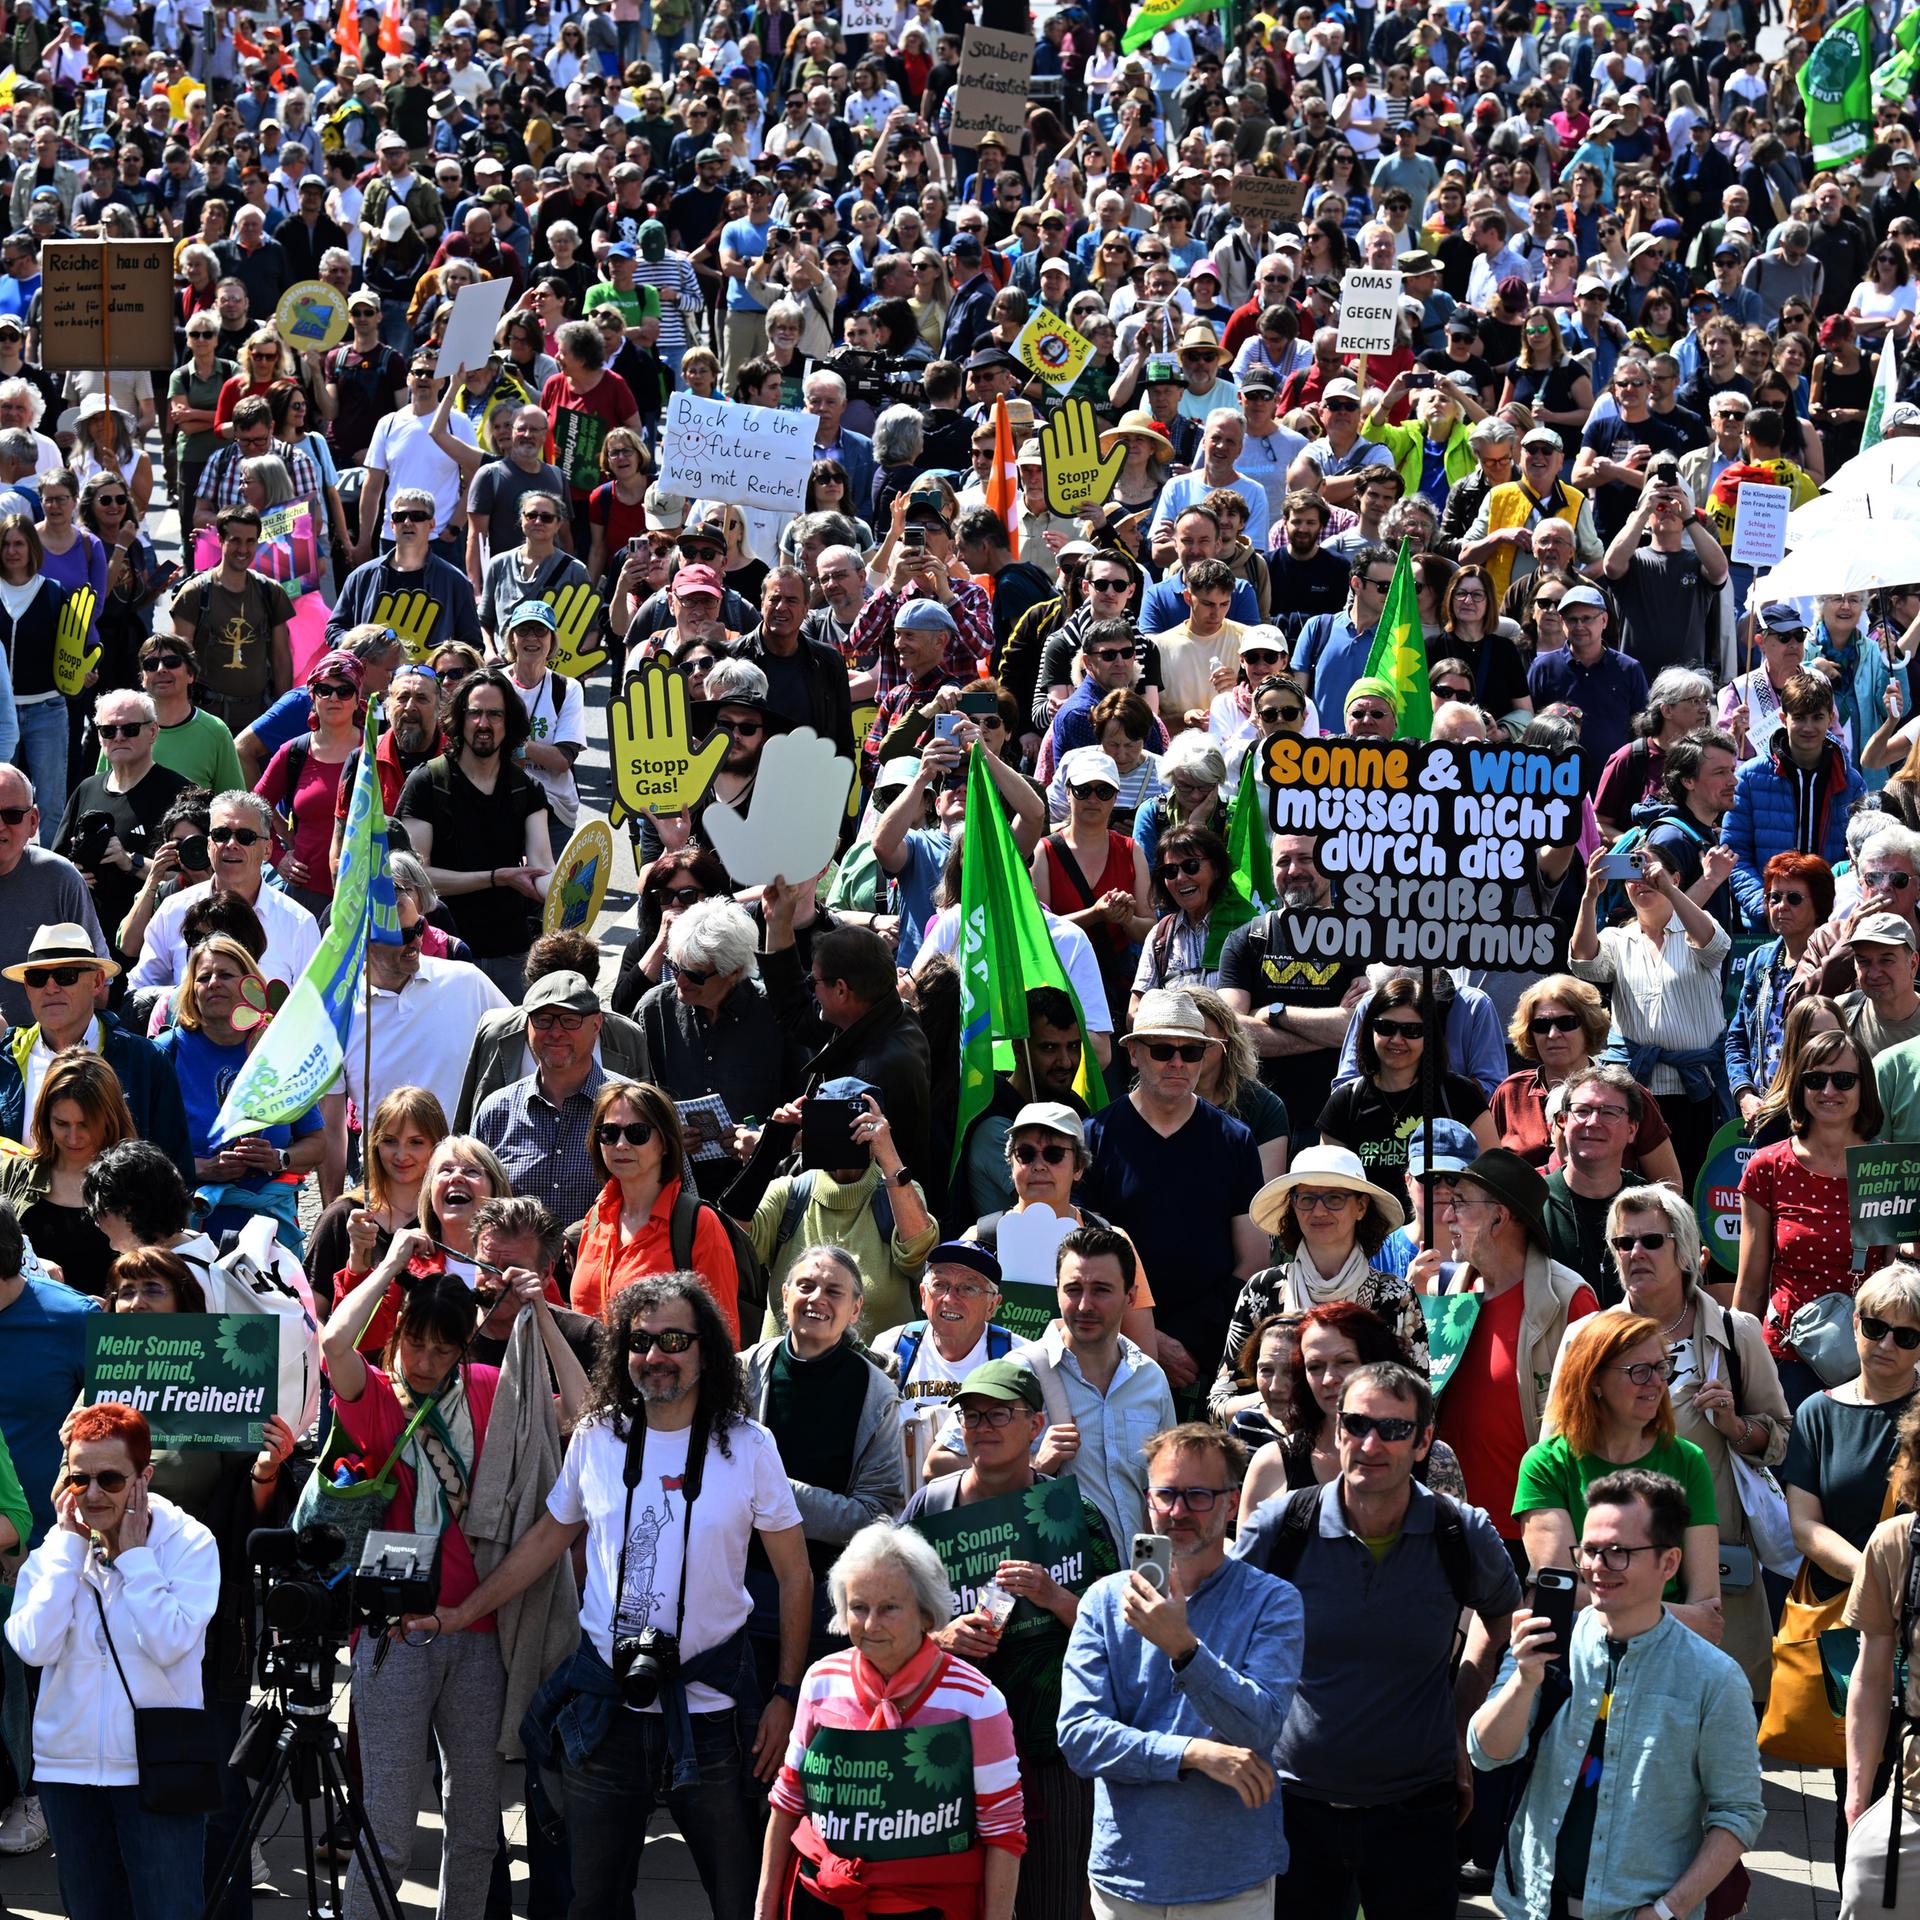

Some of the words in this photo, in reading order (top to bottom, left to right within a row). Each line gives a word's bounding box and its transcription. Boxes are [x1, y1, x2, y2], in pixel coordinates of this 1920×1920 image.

[969, 41, 1029, 64] Sauber
[955, 111, 1022, 135] bezahlbar
[1234, 180, 1298, 194] NOSTALGIE
[1232, 204, 1299, 221] STRATEGIE
[49, 254, 100, 272] Reiche
[116, 253, 140, 270] hau
[143, 253, 161, 270] ab
[1350, 275, 1393, 290] OMAS
[54, 301, 76, 313] nicht
[108, 298, 144, 313] dumm
[1346, 305, 1393, 320] GEGEN
[1038, 311, 1089, 353] REICHE
[1340, 336, 1391, 350] RECHTS
[1022, 343, 1035, 369] NEIN
[1033, 366, 1067, 382] DANKE
[678, 399, 728, 428] Back
[743, 411, 760, 432] to
[773, 416, 799, 436] the
[709, 434, 771, 461] future
[671, 466, 701, 488] weg
[711, 470, 738, 487] mit
[747, 475, 803, 499] Reiche!
[1058, 469, 1099, 486] Stopp
[1061, 484, 1091, 501] Gas!
[1752, 490, 1786, 501] Klimapolitik
[1753, 500, 1765, 508] Frau
[1744, 529, 1766, 539] Gesicht
[1748, 520, 1766, 529] Schlag
[1746, 539, 1772, 548] nächsten
[1737, 548, 1778, 560] Generationen.
[59, 648, 82, 669] Stopp
[58, 664, 76, 681] Gas!
[631, 759, 689, 776] Stopp
[1269, 738, 1409, 789] Sonne
[1418, 748, 1462, 791] &
[1470, 750, 1580, 797] Wind
[636, 777, 678, 795] Gas!
[1276, 787, 1440, 835] müssen
[1454, 793, 1570, 841] nicht
[1321, 829, 1447, 877] durch
[1458, 837, 1525, 880] die
[1343, 872, 1502, 922] Straße
[1288, 914, 1372, 958] von
[1385, 918, 1556, 966] Hormus
[1359, 1138, 1407, 1155] GRÜN
[1379, 1153, 1408, 1167] HERZ
[1857, 1160, 1899, 1178] Mehr
[1858, 1178, 1902, 1196] mehr
[1859, 1195, 1917, 1219] mehr
[96, 1335, 144, 1356] Mehr
[144, 1335, 206, 1360] Sonne,
[95, 1360, 144, 1380] mehr
[146, 1360, 196, 1384] Wind,
[95, 1385, 160, 1412] mehr
[160, 1385, 265, 1413] Freiheit!
[156, 1434, 170, 1443] ins
[170, 1433, 193, 1444] grüne
[193, 1434, 213, 1443] Team
[214, 1434, 243, 1445] Bayern:
[956, 1522, 1020, 1553] Sonne,
[965, 1545, 1012, 1578] Wind
[803, 1750, 833, 1776] Mehr
[833, 1754, 894, 1782] Sonne,
[806, 1780, 834, 1804] mehr
[836, 1782, 886, 1810] Wind,
[853, 1797, 963, 1841] Freiheit!
